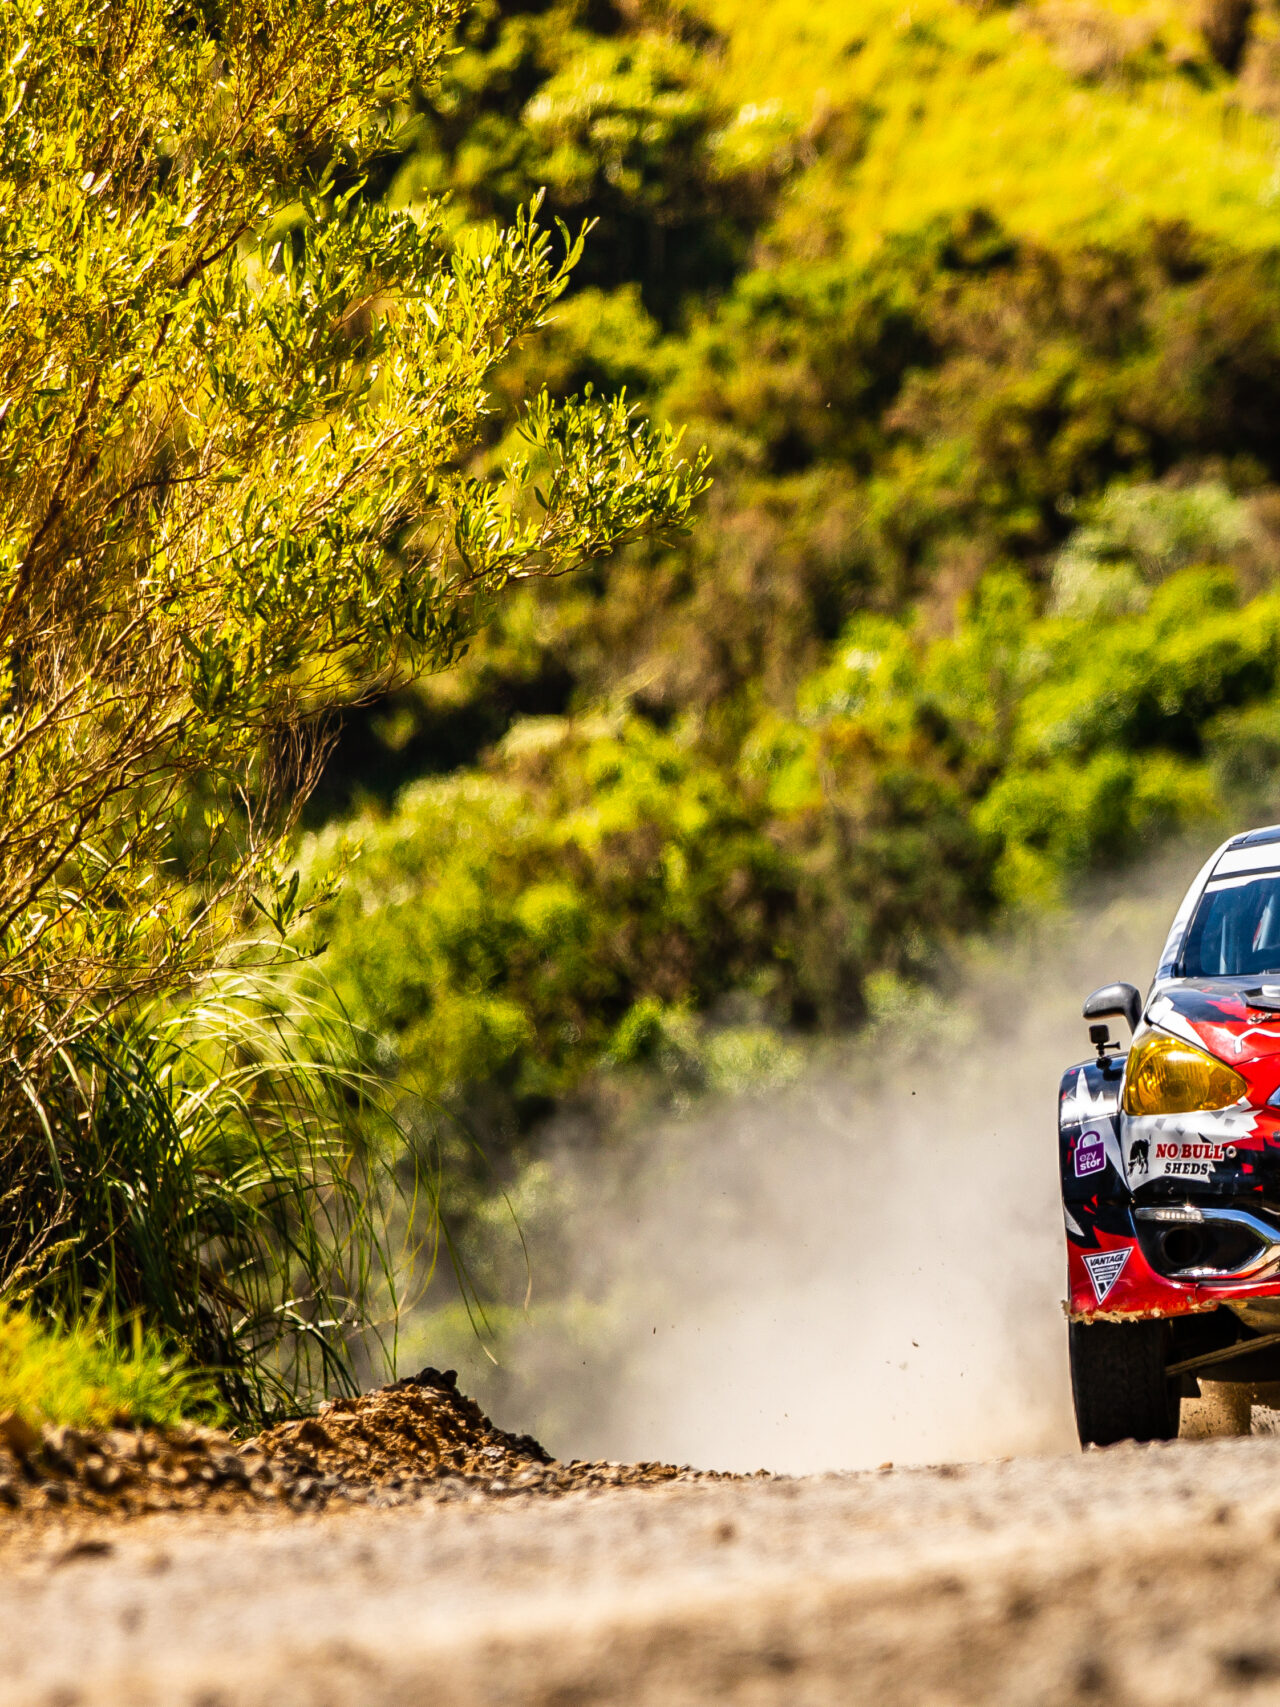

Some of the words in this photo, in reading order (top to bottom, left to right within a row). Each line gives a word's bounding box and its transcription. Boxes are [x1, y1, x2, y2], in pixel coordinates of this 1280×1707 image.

[1156, 1143, 1179, 1159] NO
[1180, 1144, 1223, 1160] BULL
[1080, 1158, 1101, 1171] stor
[1164, 1162, 1208, 1175] SHEDS
[1090, 1253, 1125, 1267] VANTAGE
